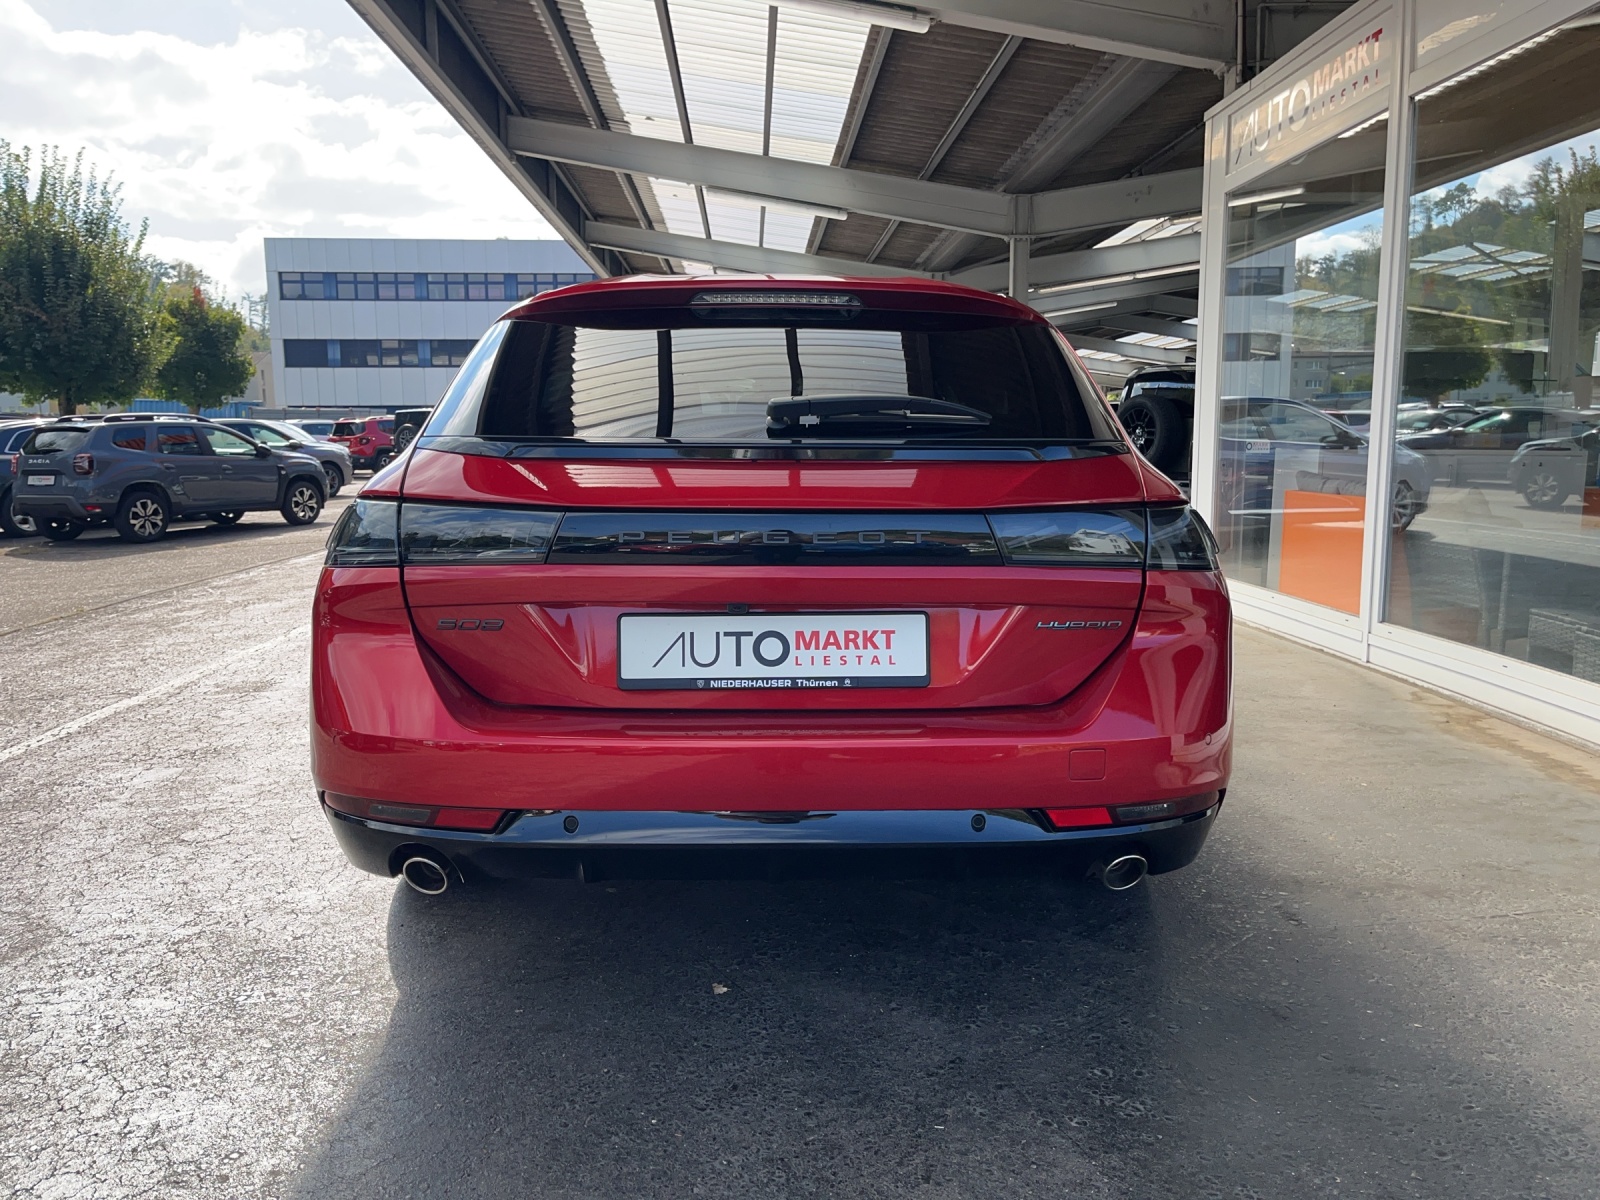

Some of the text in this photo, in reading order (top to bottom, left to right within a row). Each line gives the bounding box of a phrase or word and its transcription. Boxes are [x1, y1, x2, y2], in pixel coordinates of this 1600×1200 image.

[1235, 28, 1383, 165] AUTO MARKT
[1312, 69, 1380, 121] LIESTAL
[618, 531, 932, 544] PEUGEOT
[437, 619, 504, 631] 508
[652, 630, 896, 668] AUTO MARKT
[795, 655, 896, 666] LIESTAL
[710, 678, 838, 688] NIEDERHAUSER Thürnen
